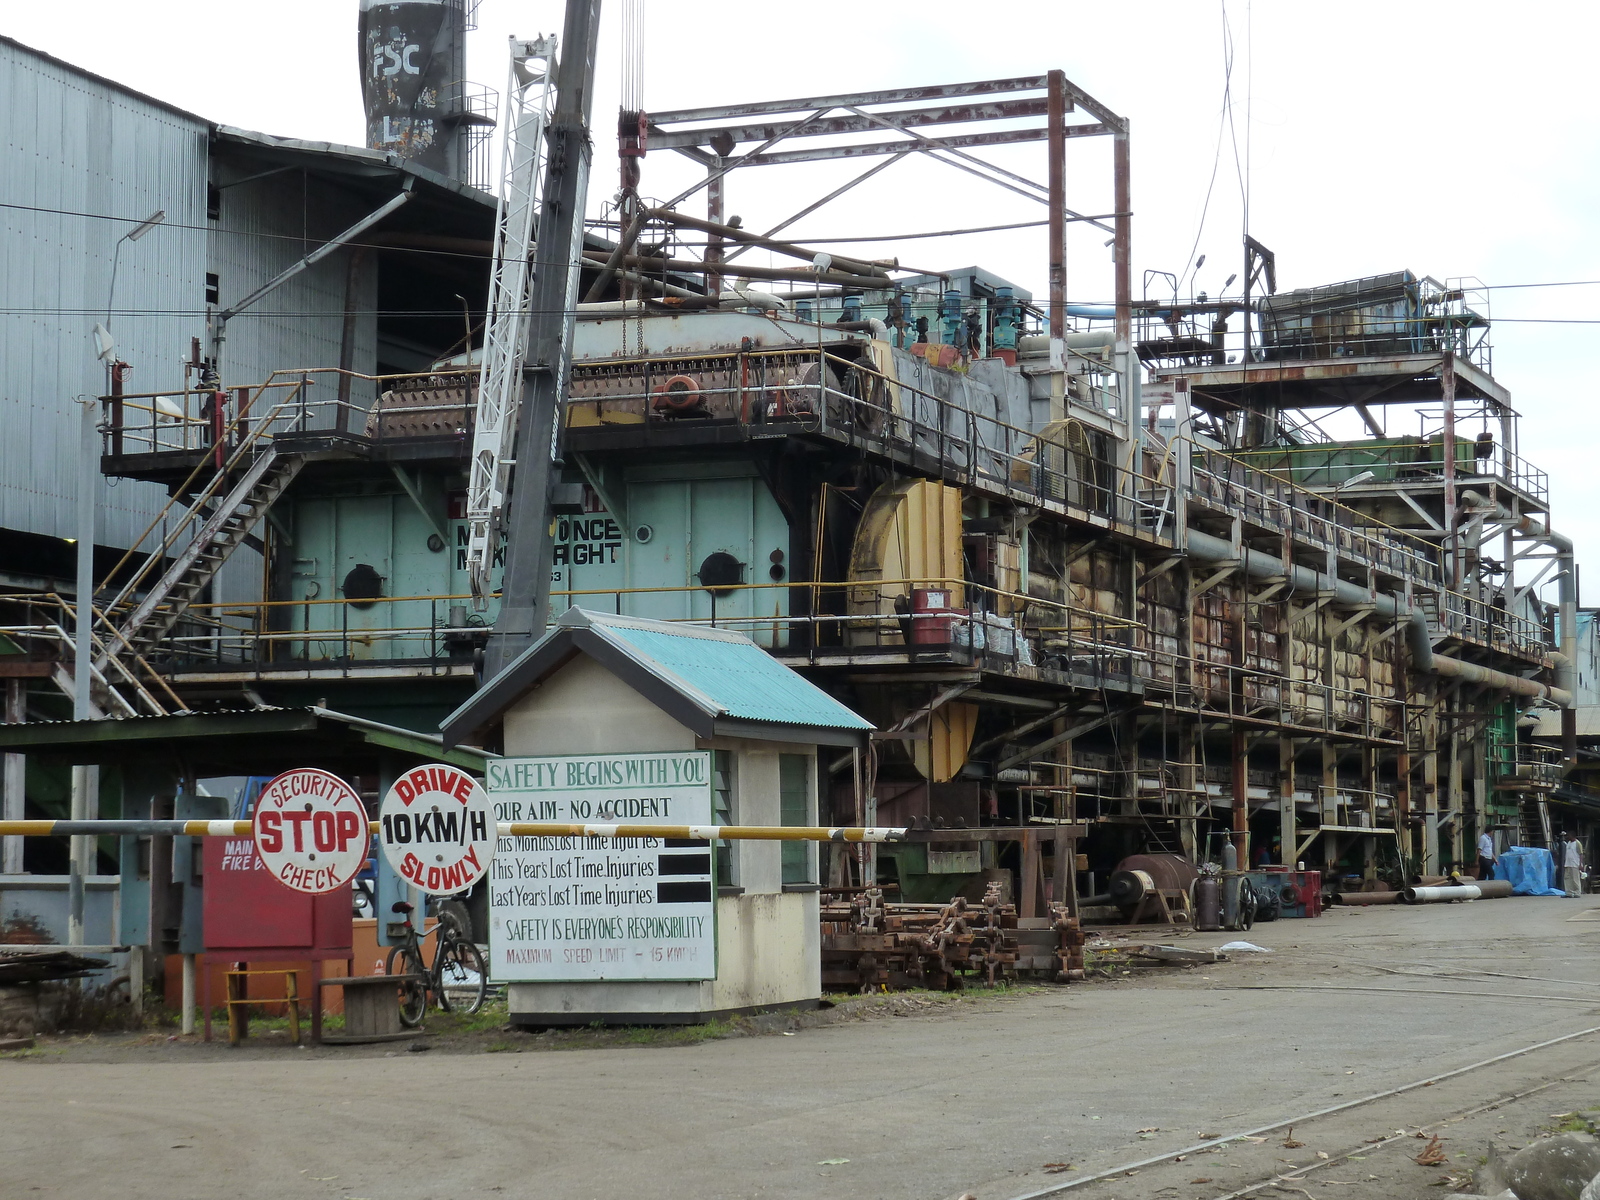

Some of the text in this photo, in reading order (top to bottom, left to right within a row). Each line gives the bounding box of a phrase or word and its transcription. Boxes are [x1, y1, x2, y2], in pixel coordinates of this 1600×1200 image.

[374, 43, 420, 77] FSC
[555, 354, 565, 403] CRANE
[559, 519, 621, 541] ONCE
[490, 757, 704, 789] SAFETY BEGINS WITH YOU
[271, 775, 348, 808] SECURITY
[394, 768, 474, 807] DRIVE
[494, 801, 522, 821] OUR
[570, 800, 591, 819] NO
[595, 798, 672, 818] ACCIDENT
[259, 811, 360, 853] STOP
[496, 837, 513, 852] his
[225, 840, 254, 855] MAIN
[221, 856, 251, 871] FIRE
[280, 862, 341, 890] CHECK
[400, 844, 482, 890] SLOWLY
[491, 859, 513, 880] This
[550, 857, 572, 878] Lost
[491, 886, 514, 907] Last
[549, 885, 571, 906] Lost
[573, 884, 602, 905] Time
[506, 916, 705, 941] SAFETY IS EVERYONE'S RESPONSIBILITY
[506, 949, 552, 964] MAXIMUM
[563, 948, 593, 963] SPEED
[599, 947, 627, 963] LIMIT
[650, 947, 663, 962] 15
